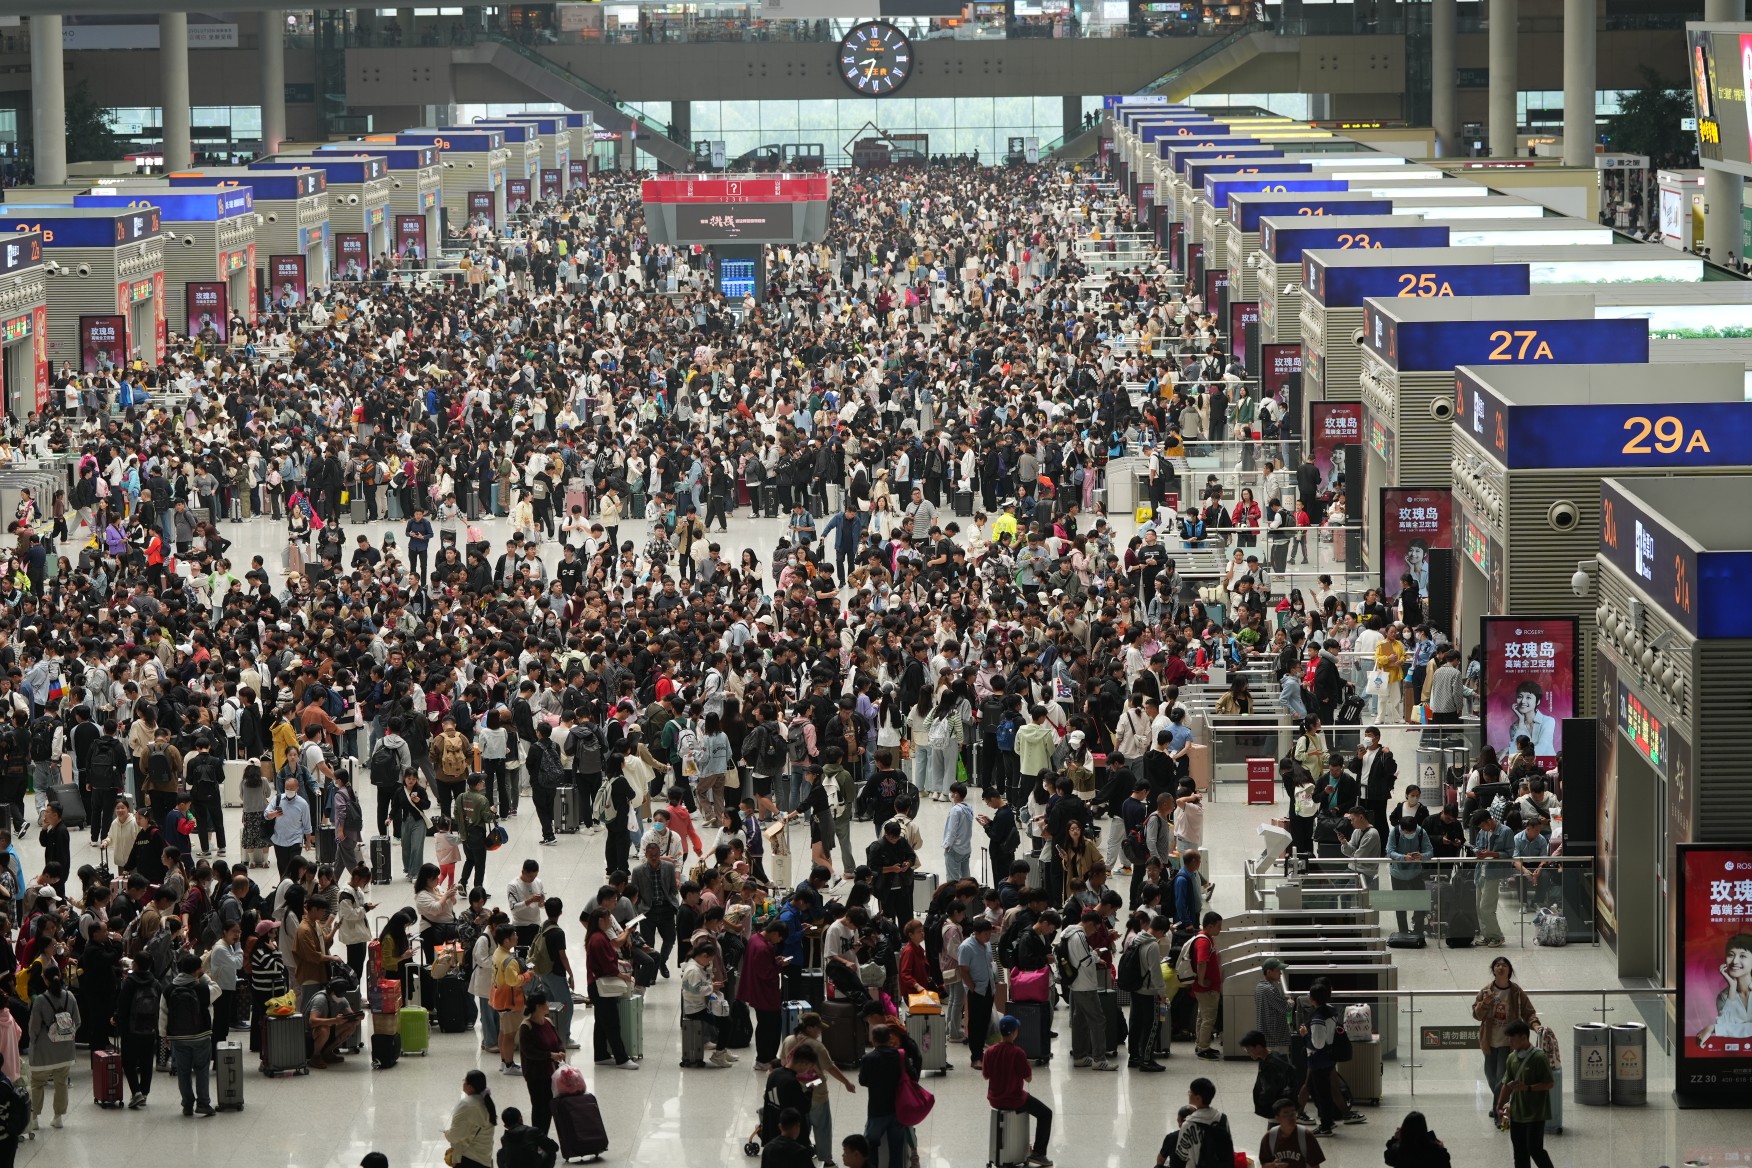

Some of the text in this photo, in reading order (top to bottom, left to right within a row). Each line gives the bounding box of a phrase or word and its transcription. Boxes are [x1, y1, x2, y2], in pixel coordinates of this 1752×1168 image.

[1397, 273, 1455, 298] 25A
[1488, 330, 1554, 360] 27A
[1275, 357, 1302, 367] 玫瑰岛
[1325, 417, 1358, 428] 玫瑰岛
[1622, 415, 1711, 454] 29A
[1399, 507, 1438, 520] 玫瑰岛
[1603, 498, 1618, 550] 30A
[1675, 554, 1690, 614] 31A
[1504, 641, 1555, 658] 玫瑰岛
[1504, 659, 1555, 669] 高端全卫定制
[1690, 1075, 1717, 1083] ZZ 30
